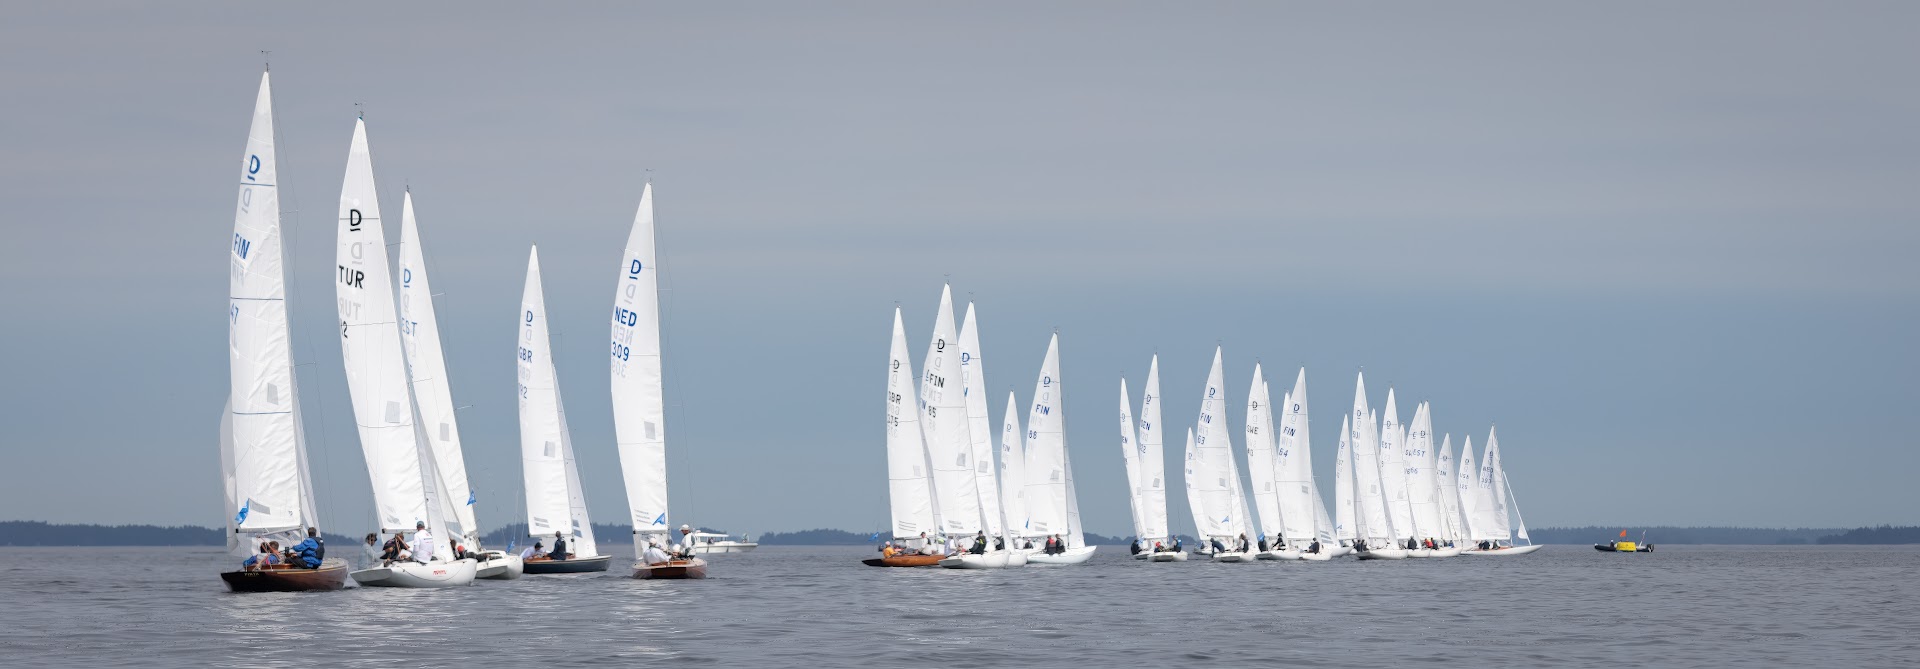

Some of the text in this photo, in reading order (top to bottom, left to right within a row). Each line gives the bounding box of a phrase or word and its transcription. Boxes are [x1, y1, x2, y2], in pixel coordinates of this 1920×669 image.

[249, 154, 261, 174] D
[350, 209, 362, 226] D
[233, 232, 250, 260] FIN
[630, 259, 642, 274] D
[338, 264, 365, 289] TUR
[404, 268, 411, 283] D
[526, 310, 533, 323] D
[615, 306, 637, 327] NED
[938, 339, 945, 349] D
[519, 346, 533, 364] GBR
[612, 341, 630, 362] 309
[962, 352, 970, 362] D
[894, 359, 900, 369] D
[929, 373, 945, 388] FIN
[1044, 376, 1051, 385] D
[1146, 394, 1152, 402] D
[1209, 387, 1216, 396] D
[1035, 404, 1050, 415] FIN
[1253, 401, 1258, 409] D
[1200, 412, 1212, 424] FIN
[1283, 426, 1296, 437] FIN
